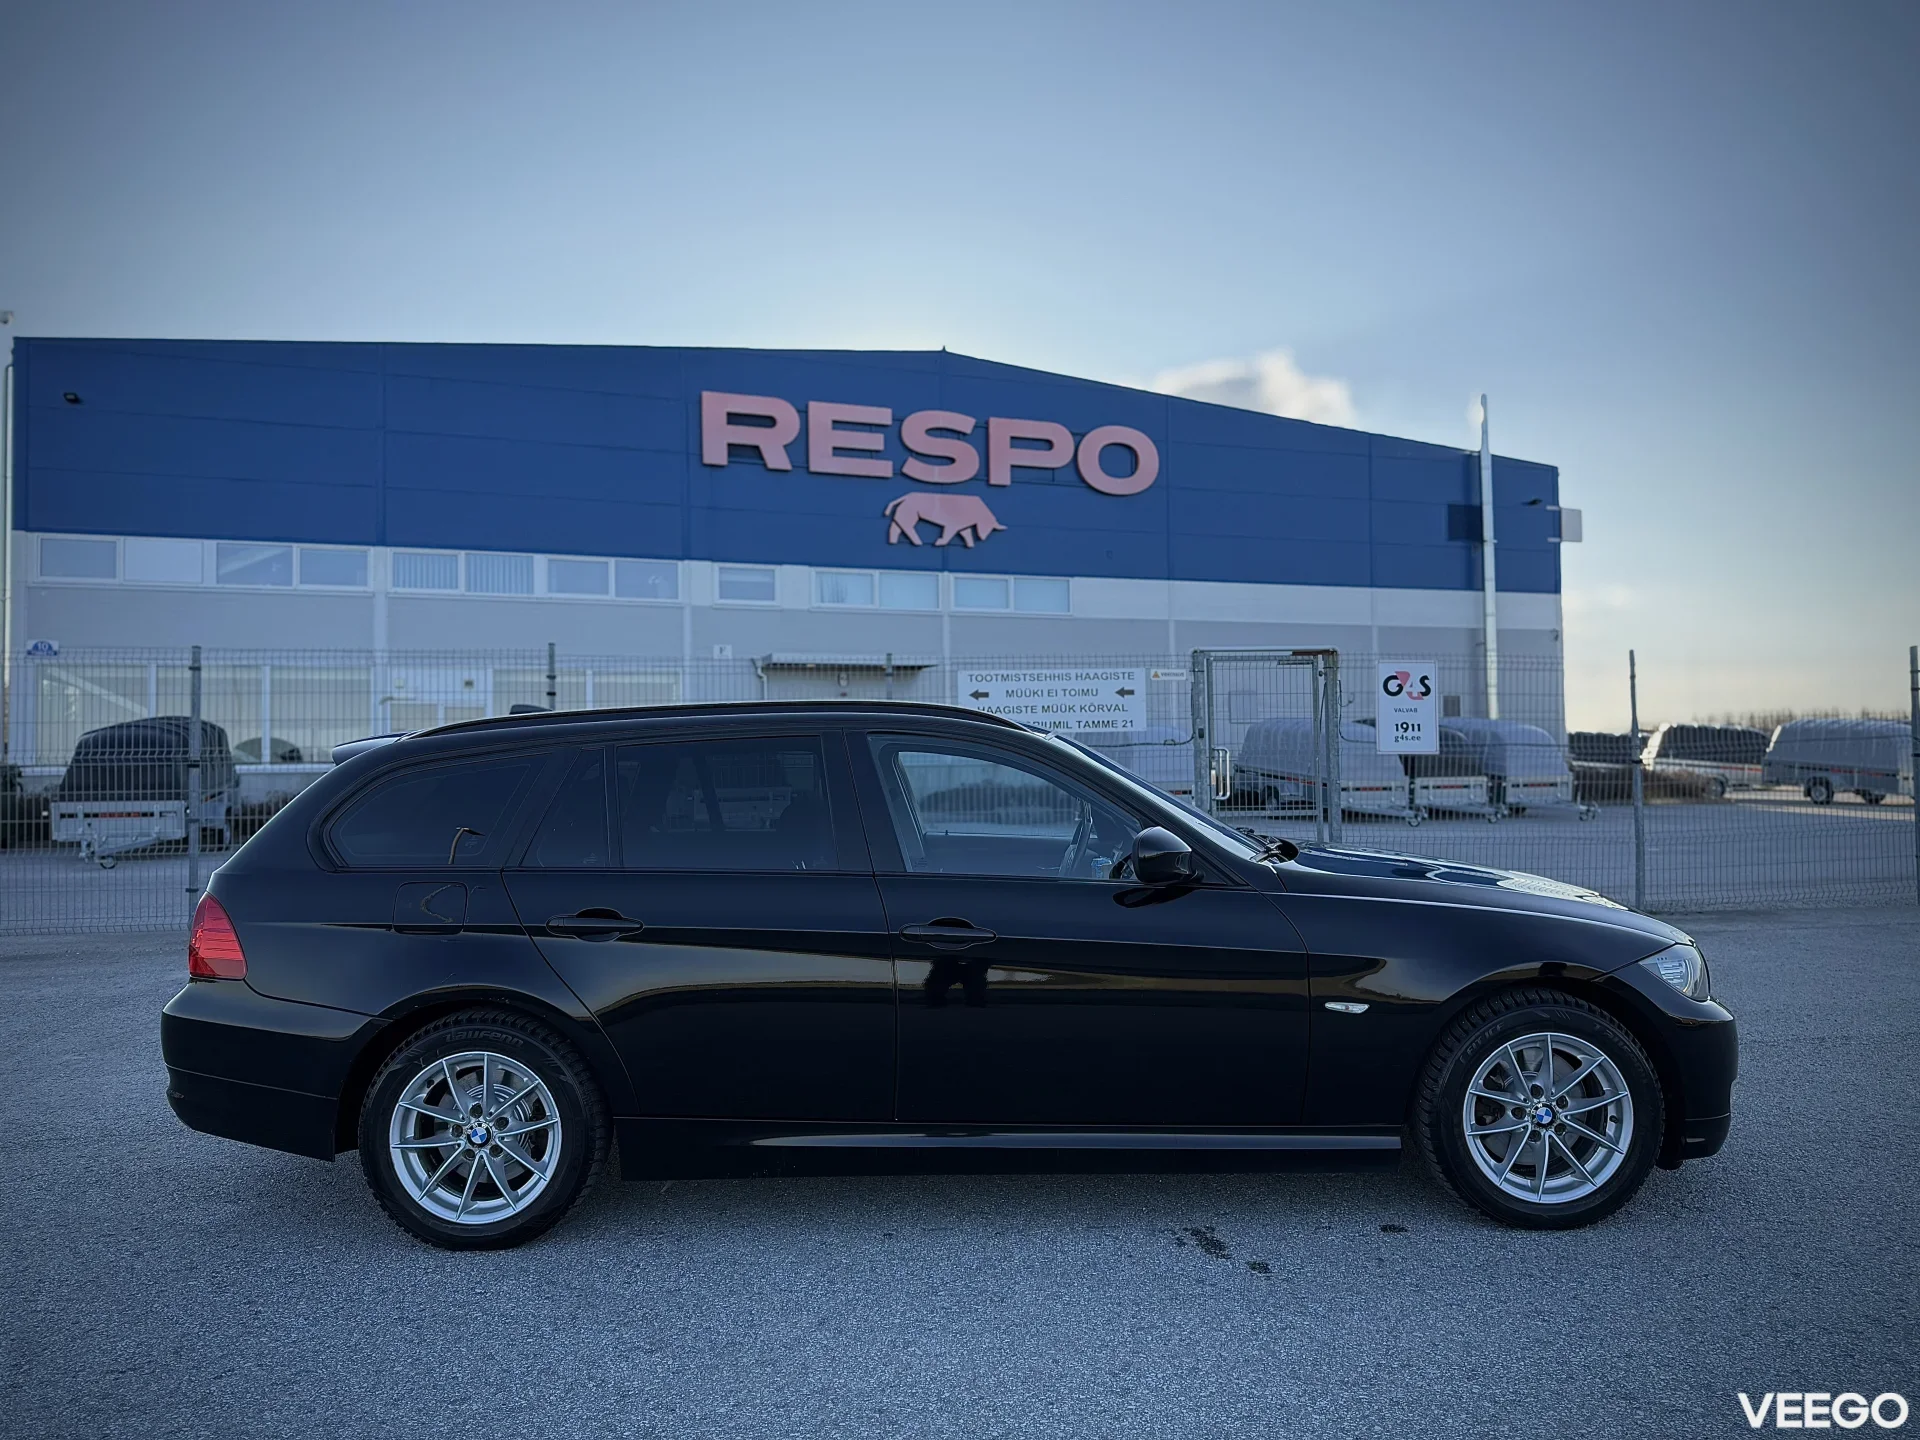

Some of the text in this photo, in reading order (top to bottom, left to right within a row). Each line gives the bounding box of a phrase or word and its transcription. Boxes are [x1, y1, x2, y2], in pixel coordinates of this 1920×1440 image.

[701, 390, 1160, 495] RESPO
[968, 671, 1135, 683] TOOTMISTSEHHIS HAAGISTE
[1383, 671, 1431, 700] G4S
[1005, 688, 1099, 698] MÜÜKI EI TOIMU
[1041, 703, 1076, 714] MÜÜK
[1079, 702, 1129, 713] KÕRVAL
[1076, 719, 1118, 729] TAMME
[1121, 719, 1134, 729] 21
[1394, 721, 1421, 733] 1911
[1394, 734, 1421, 743] g4s.ee
